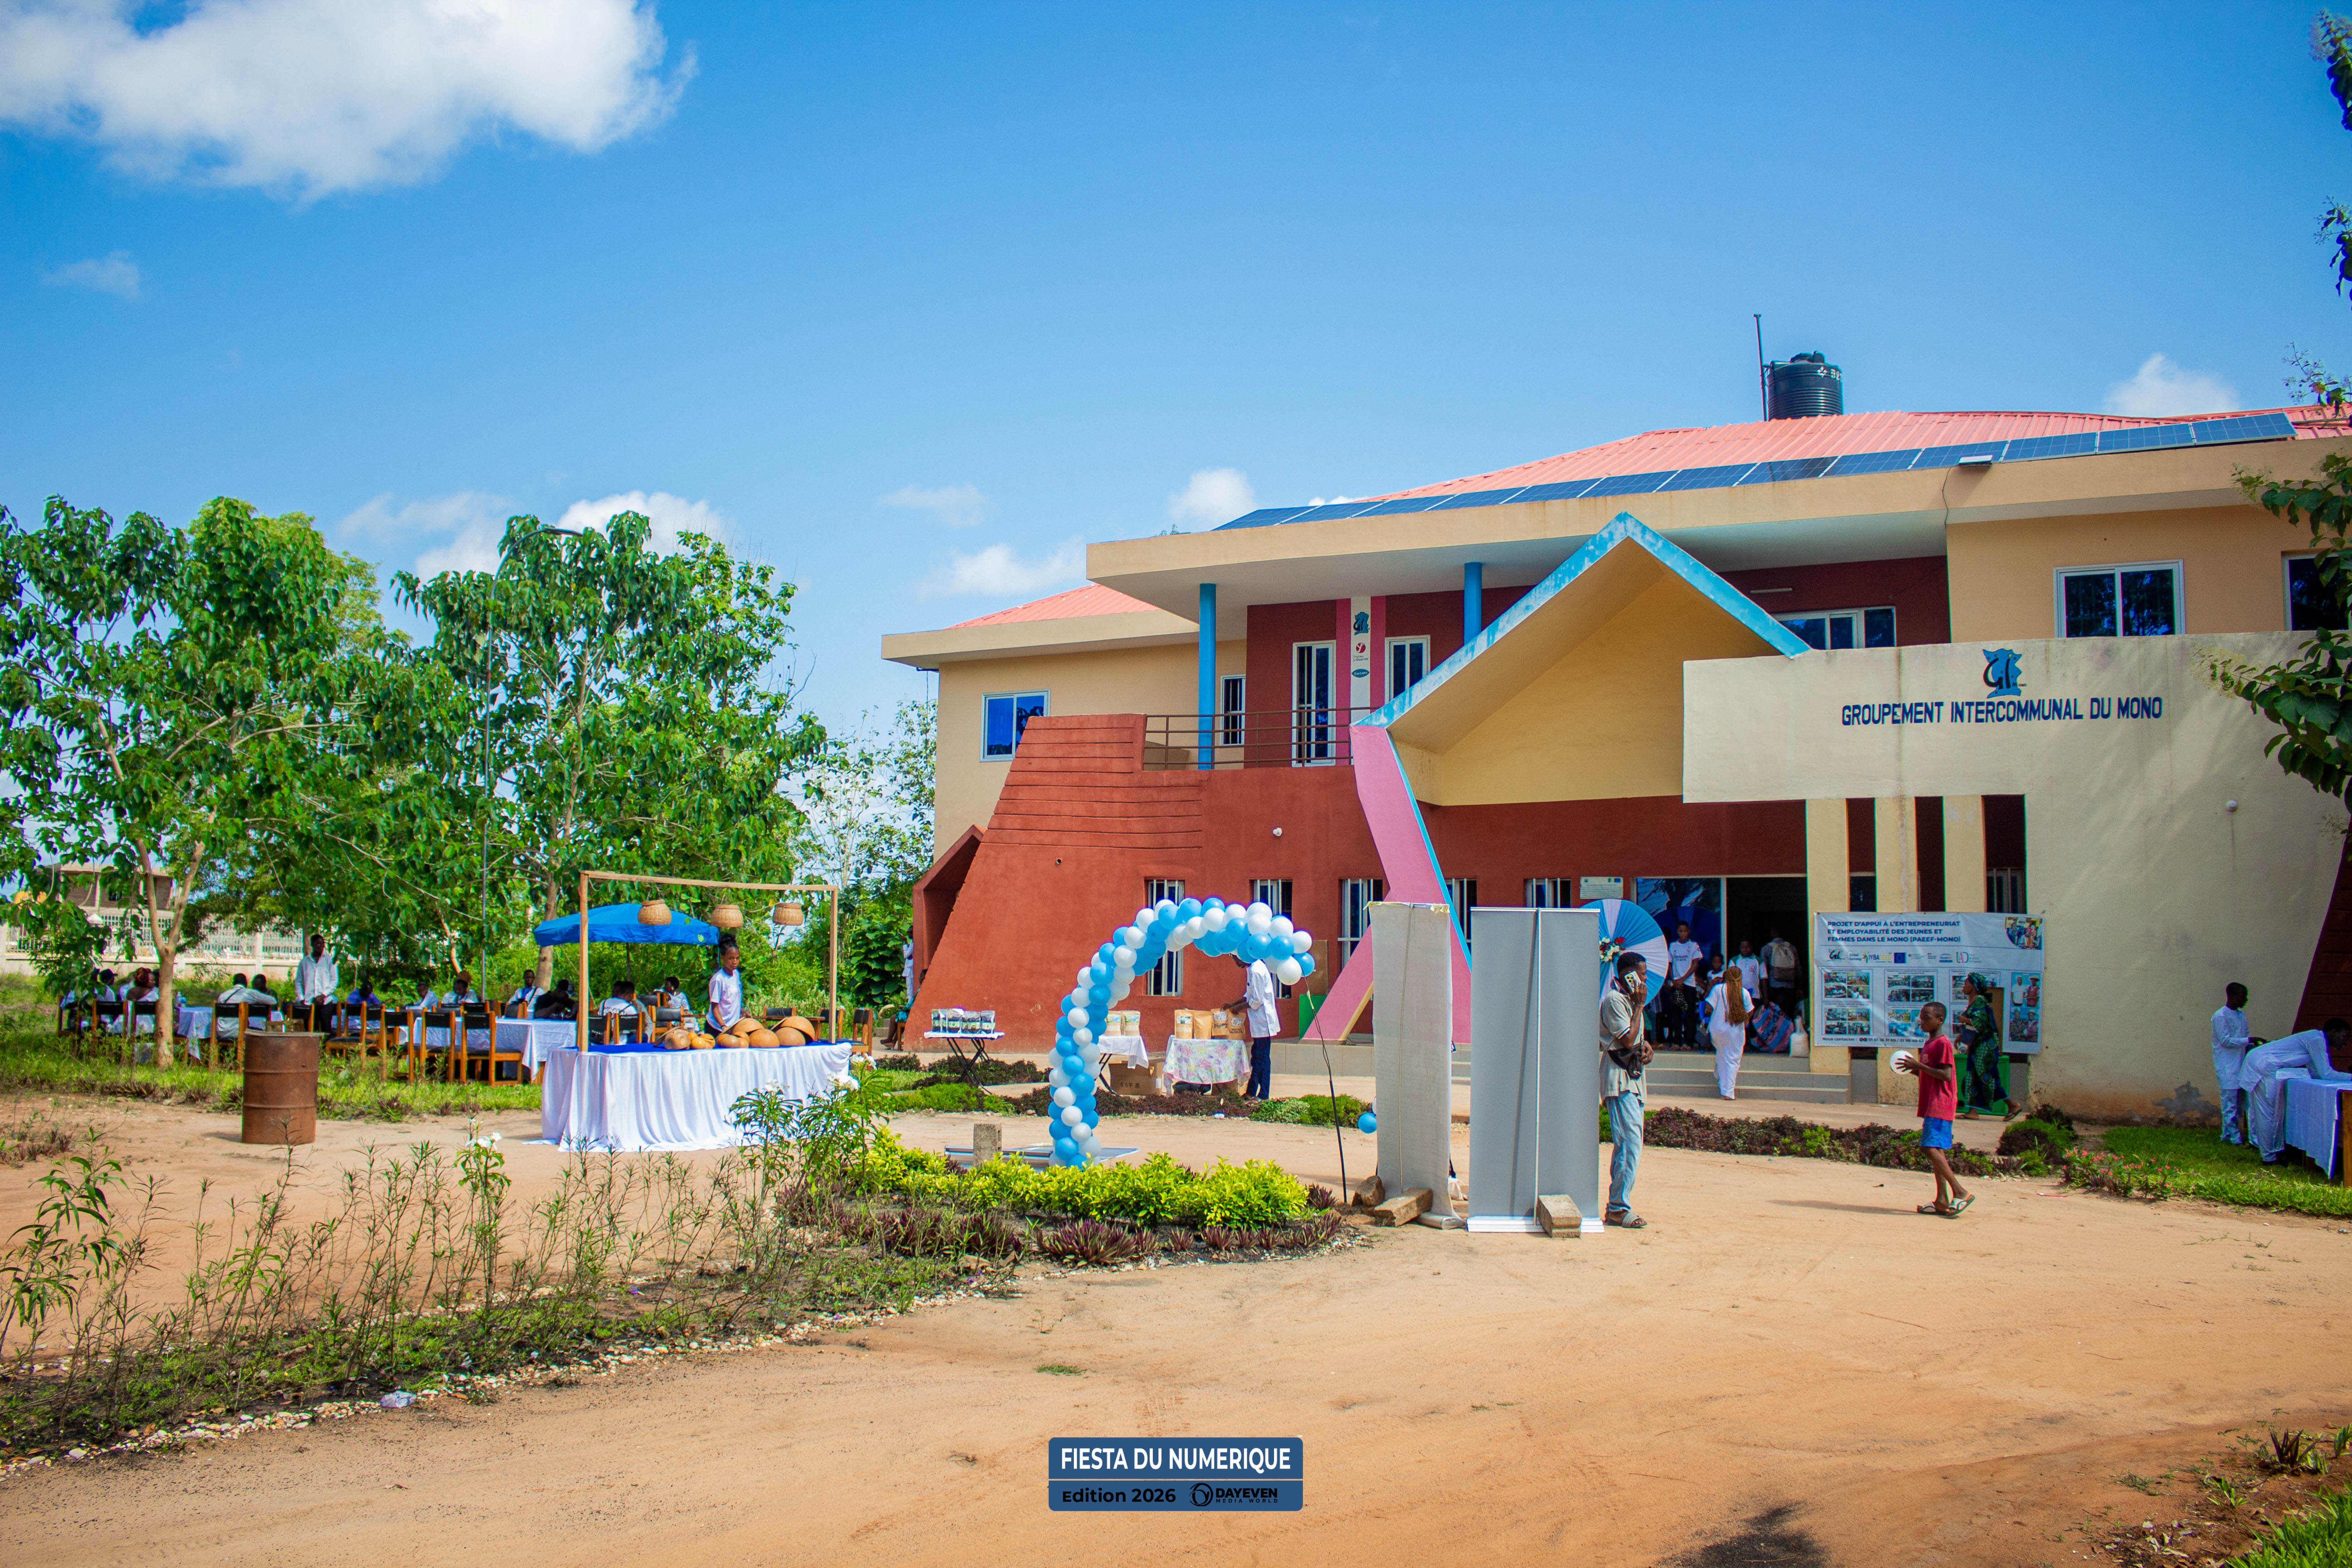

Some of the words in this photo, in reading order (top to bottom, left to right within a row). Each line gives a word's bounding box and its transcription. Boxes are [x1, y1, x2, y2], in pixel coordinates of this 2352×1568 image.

[1842, 701, 1944, 725] GROUPEMENT
[1951, 698, 2083, 723] INTERCOMMUNAL
[2090, 697, 2111, 719] DU
[2117, 696, 2163, 719] MONO
